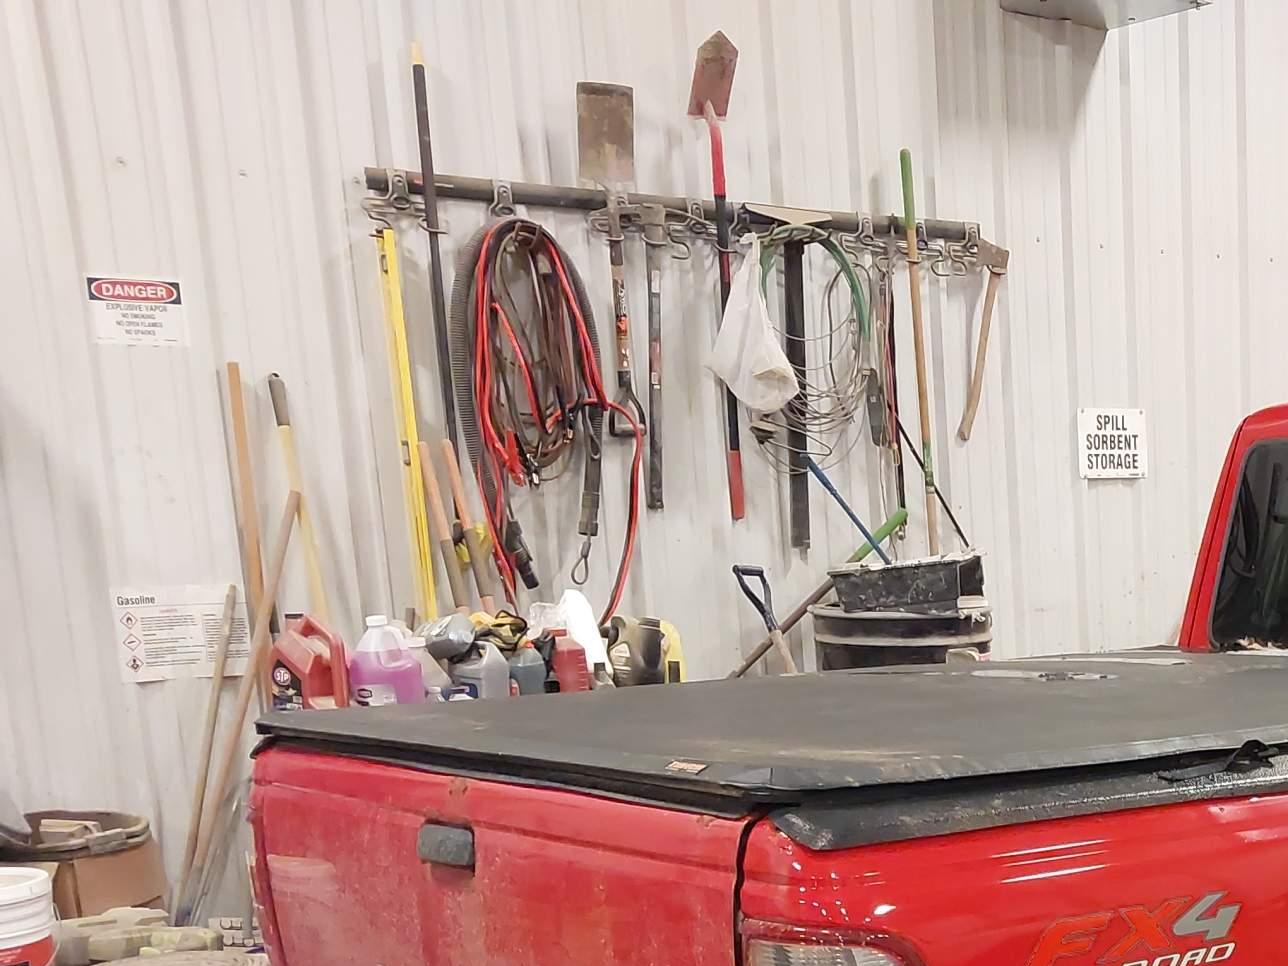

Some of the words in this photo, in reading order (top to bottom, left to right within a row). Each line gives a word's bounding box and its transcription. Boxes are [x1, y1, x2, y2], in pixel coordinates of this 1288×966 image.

[101, 283, 167, 299] DANGER
[1096, 414, 1127, 431] SPILL
[1086, 433, 1138, 450] SORBENT
[1087, 453, 1139, 470] STORAGE
[116, 595, 156, 606] Gasoline
[276, 669, 289, 683] STP
